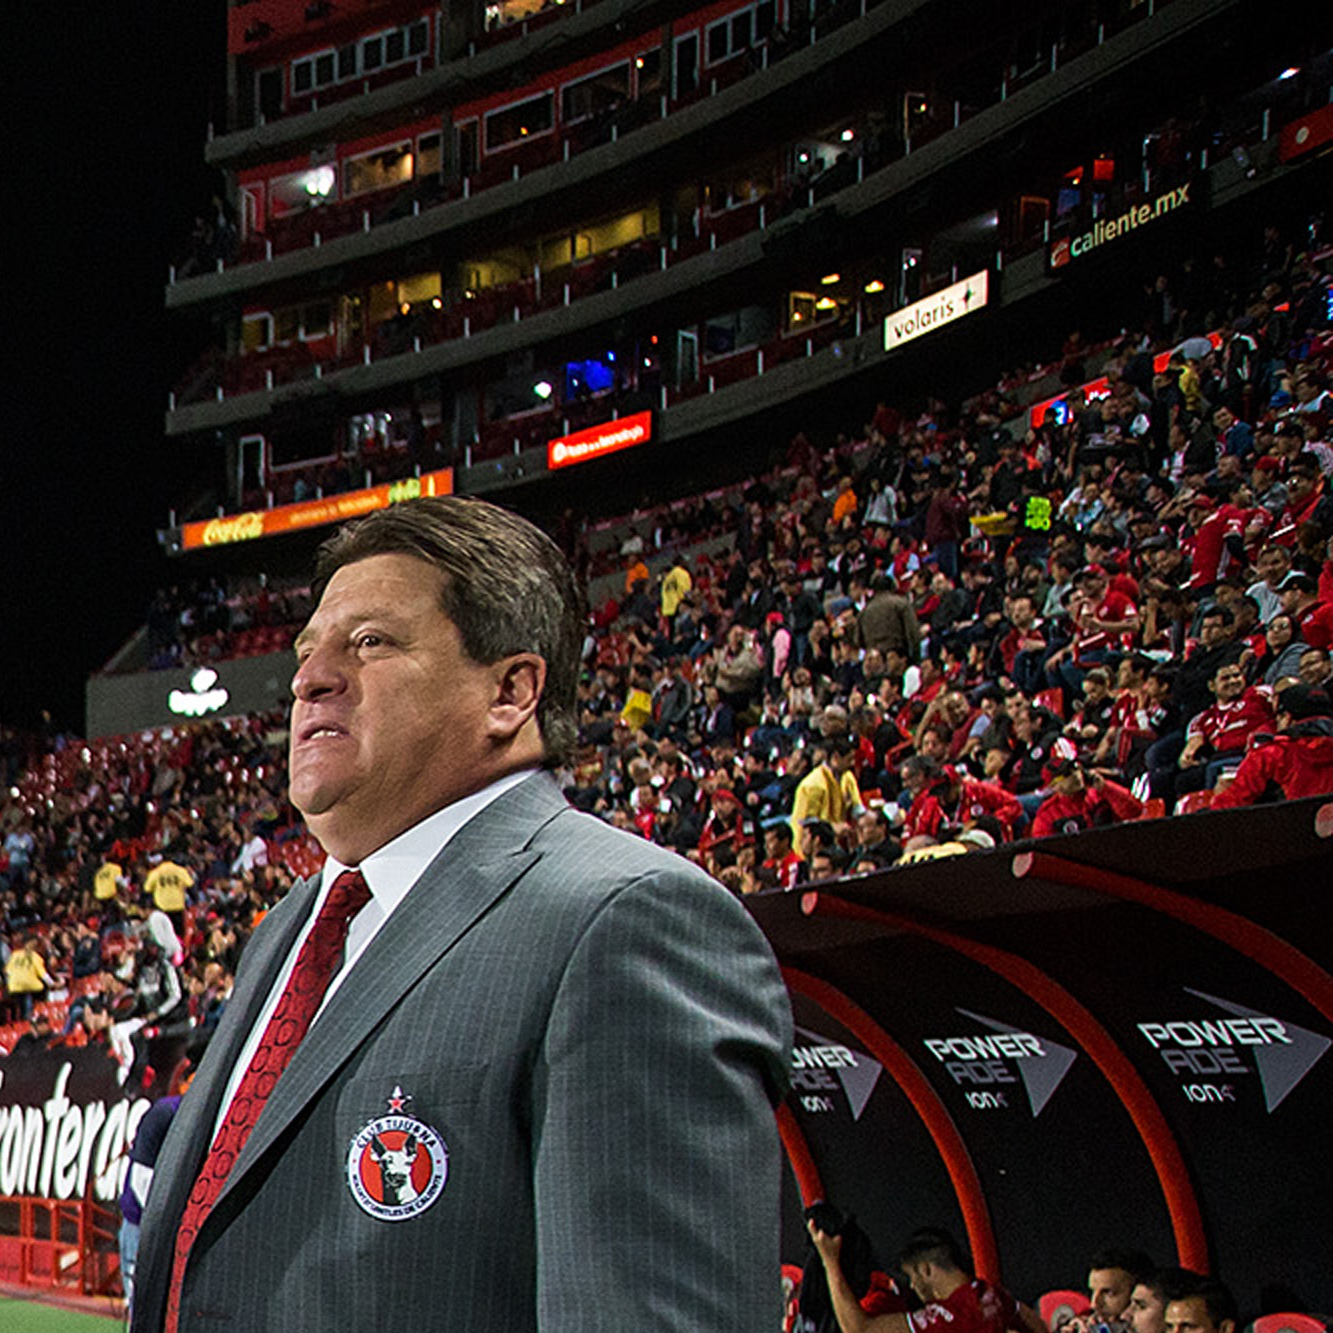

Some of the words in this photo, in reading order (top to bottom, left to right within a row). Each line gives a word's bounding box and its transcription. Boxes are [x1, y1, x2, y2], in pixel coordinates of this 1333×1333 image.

[1070, 183, 1190, 257] caliente.mx
[894, 296, 954, 339] volaris
[923, 1032, 1047, 1061] POWER
[1136, 1017, 1293, 1048] POWER
[792, 1044, 859, 1068] OWER
[1160, 1048, 1249, 1075] ADE
[945, 1060, 1016, 1085] ADE
[356, 1121, 384, 1149] CLUB
[386, 1118, 437, 1147] TIJUANA
